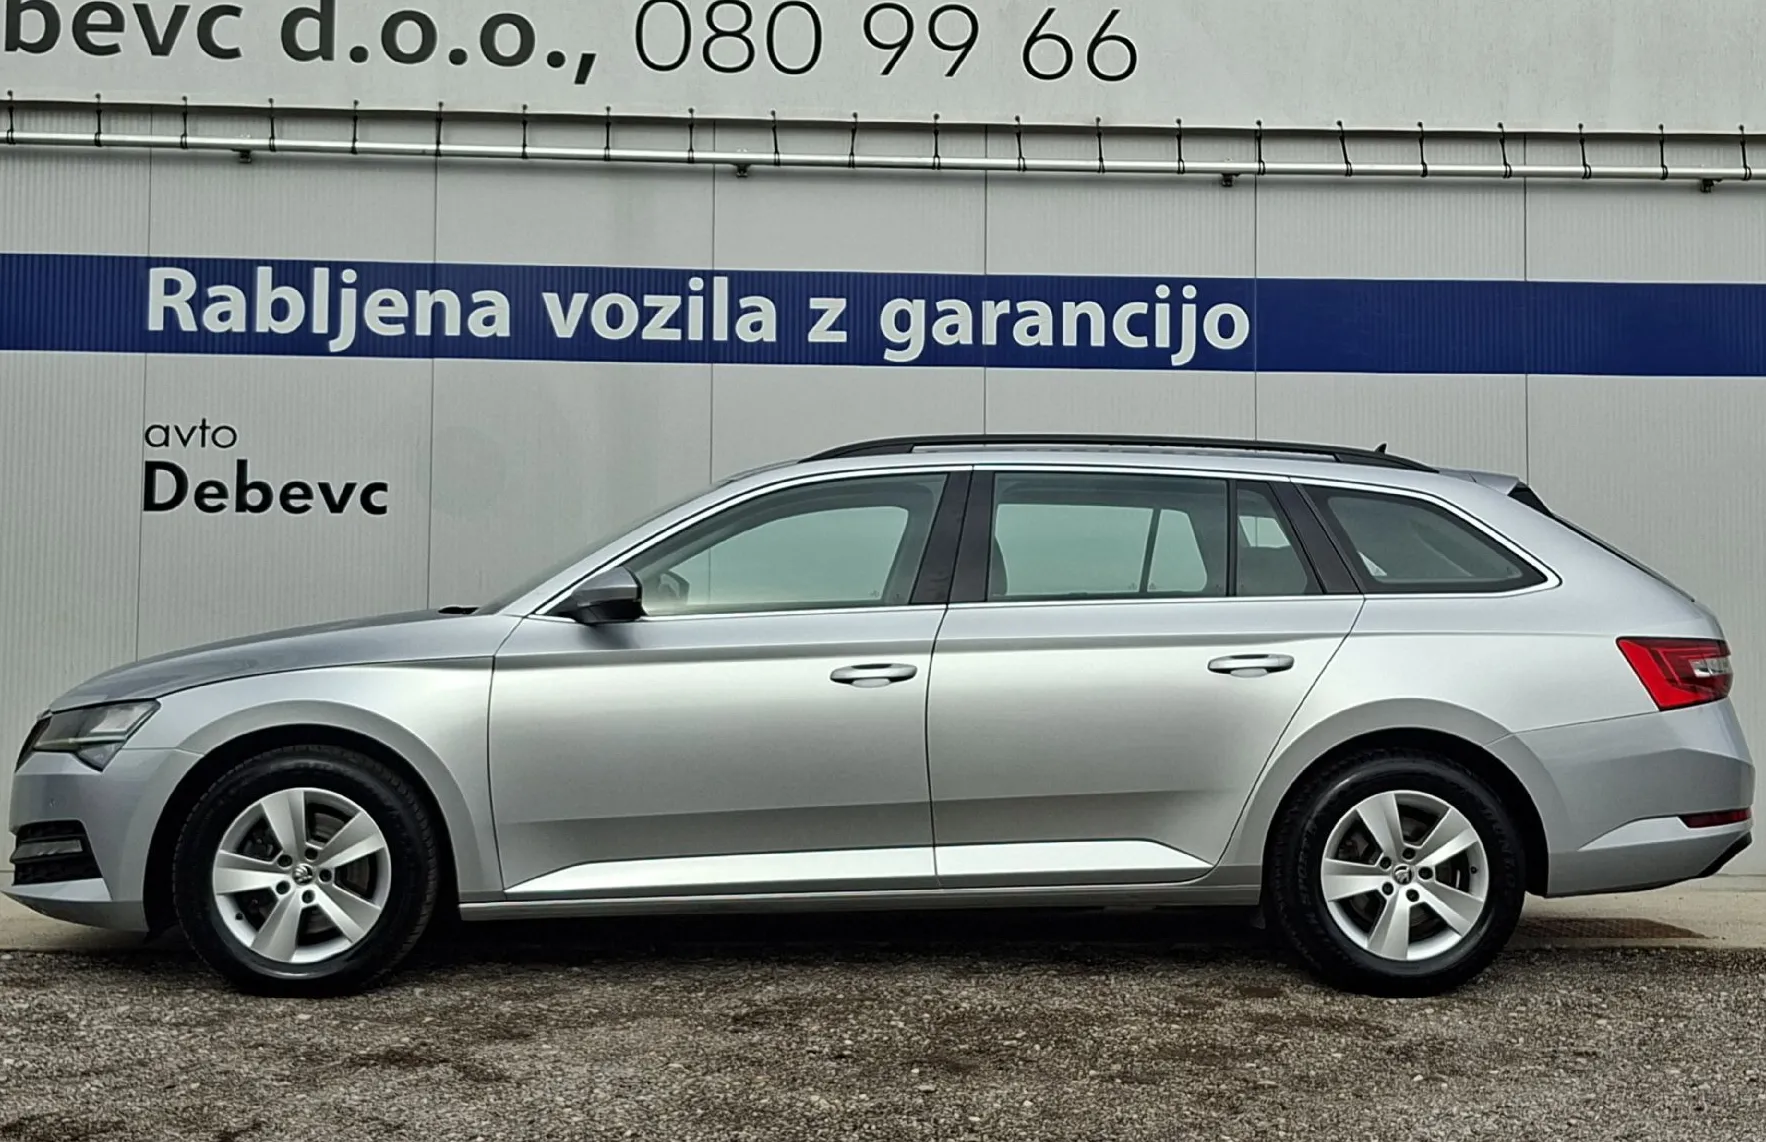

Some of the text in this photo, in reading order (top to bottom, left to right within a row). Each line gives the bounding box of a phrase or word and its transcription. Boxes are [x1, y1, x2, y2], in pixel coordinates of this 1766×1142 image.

[4, 0, 1137, 85] bevc d.o.o., 080 99 66
[147, 266, 1250, 367] Rabljena vozila z garancijo
[143, 417, 238, 449] avto
[142, 458, 389, 516] Debevc
